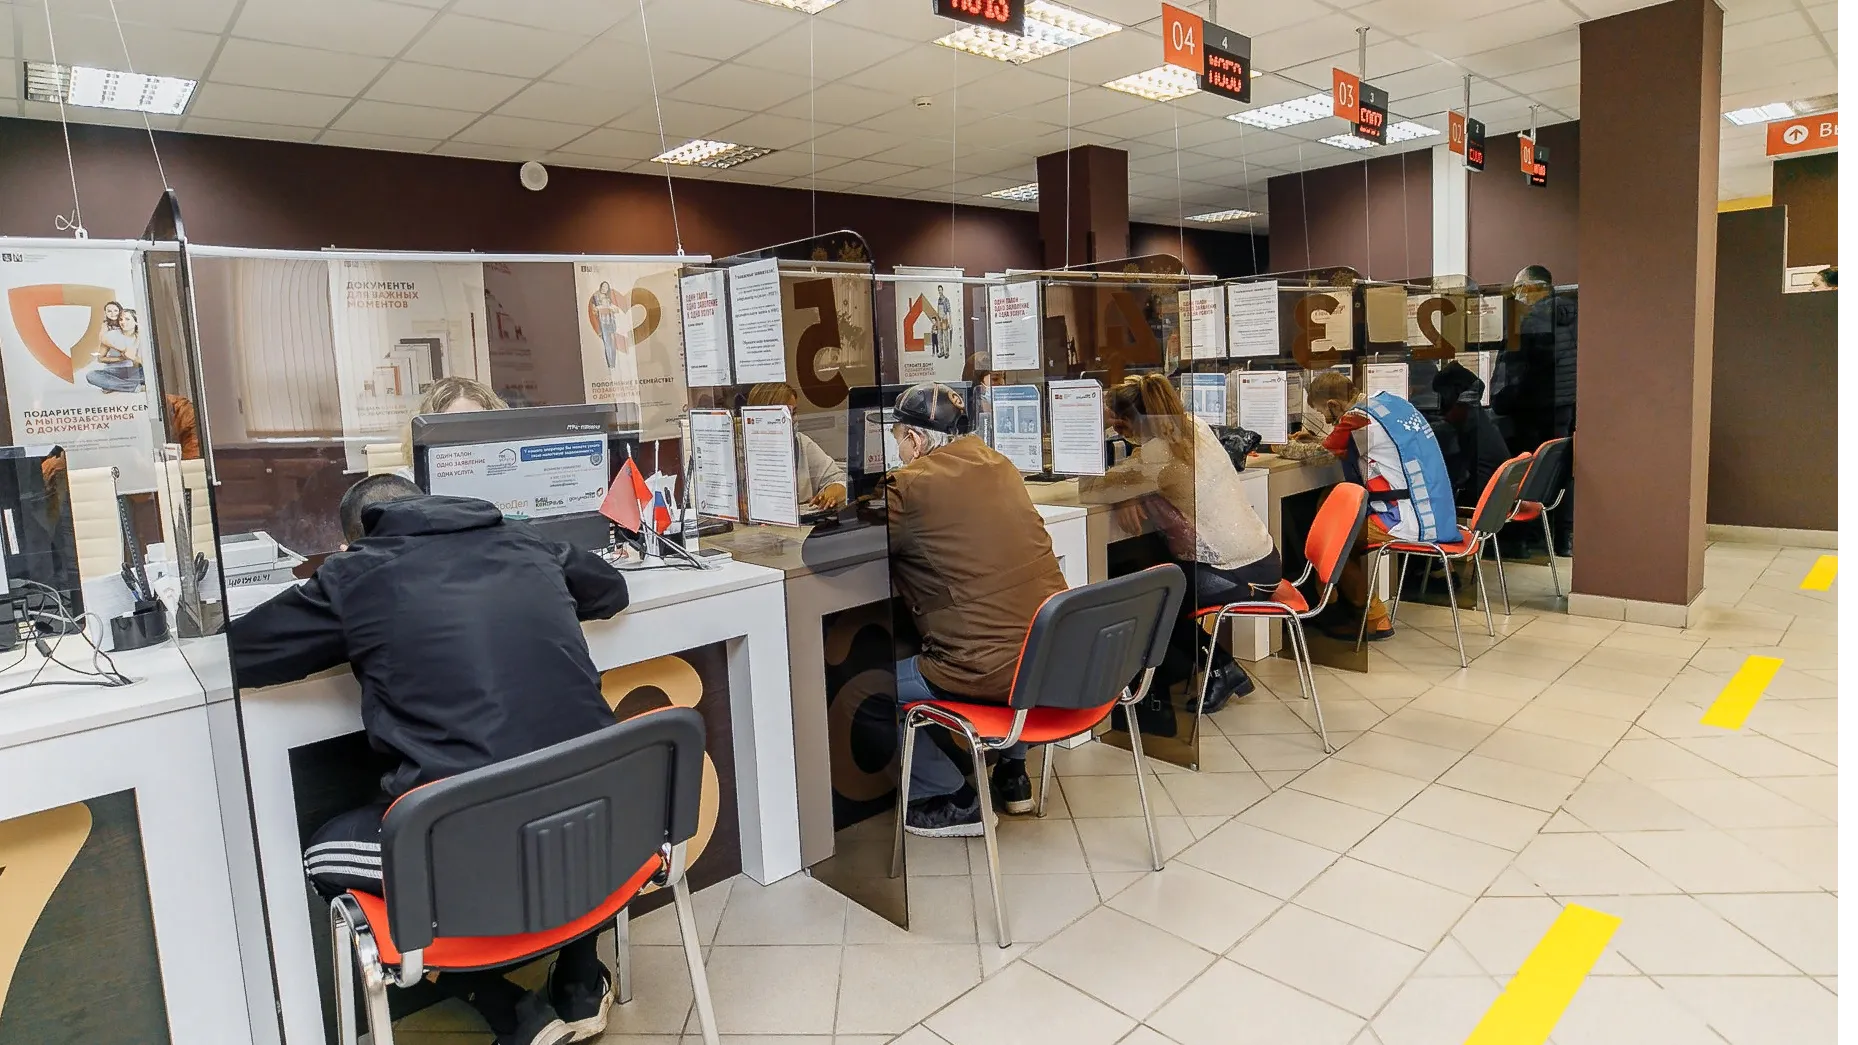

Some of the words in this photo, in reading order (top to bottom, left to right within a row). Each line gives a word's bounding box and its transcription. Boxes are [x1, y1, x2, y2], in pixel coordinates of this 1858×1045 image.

[1172, 21, 1195, 55] 04
[1222, 36, 1228, 49] 4
[1339, 81, 1354, 108] 03
[1369, 92, 1375, 103] 3
[1452, 122, 1462, 144] 02
[1523, 146, 1532, 165] 01
[346, 281, 415, 290] ДОКУМЕНТЫ
[372, 291, 419, 300] ВАЖНЫХ
[347, 300, 408, 309] МОМЕНТОВ
[24, 407, 82, 418] ПОДАРИТЕ
[85, 404, 129, 414] РЕБЕНКУ
[35, 417, 53, 425] МЫ
[56, 412, 135, 424] ПОЗАБОТИМСЯ
[37, 423, 110, 434] ДОКУМЕНТАХ
[454, 459, 486, 467] ЗАЯВЛЕНИЕ
